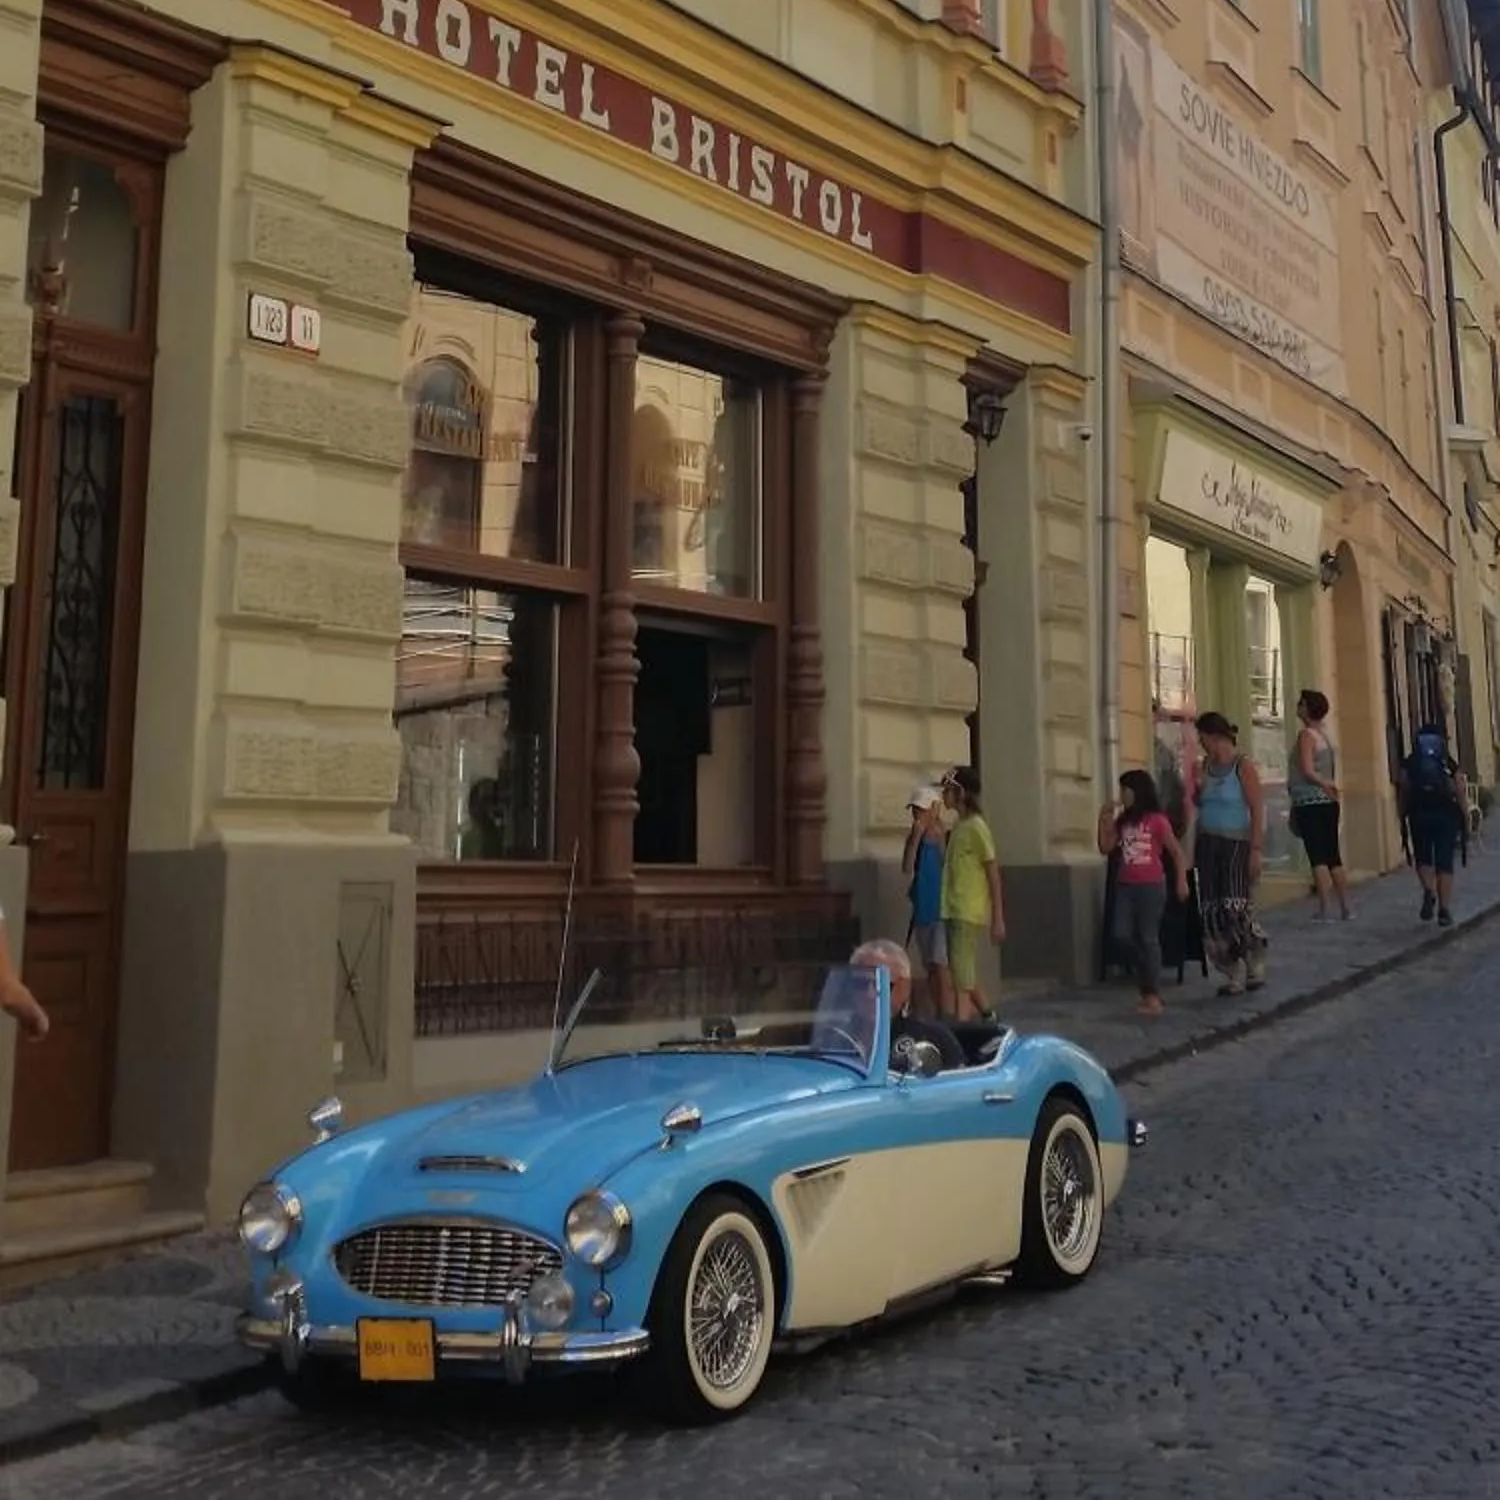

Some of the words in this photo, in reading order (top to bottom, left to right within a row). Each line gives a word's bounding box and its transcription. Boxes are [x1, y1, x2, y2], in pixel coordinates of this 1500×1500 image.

[1179, 83, 1235, 159] SOVIE
[651, 97, 873, 251] BRISTOL
[303, 314, 313, 341] 11
